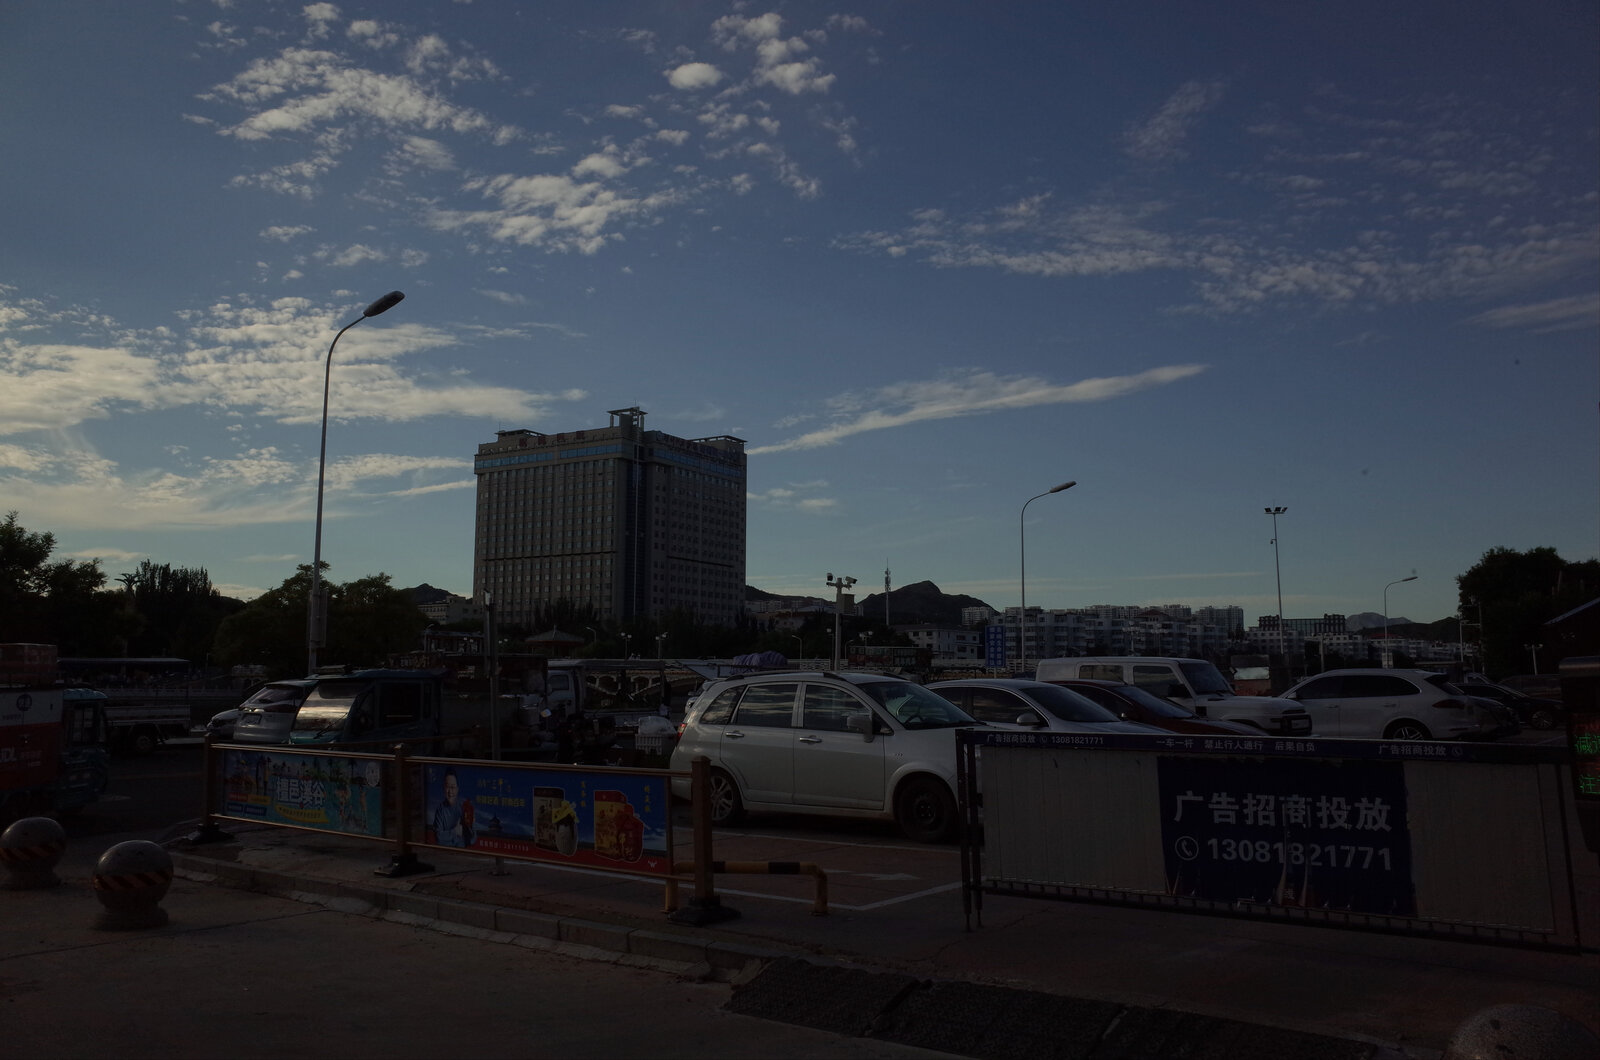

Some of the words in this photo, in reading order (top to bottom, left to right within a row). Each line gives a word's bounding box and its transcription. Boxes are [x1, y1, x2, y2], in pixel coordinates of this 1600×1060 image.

[986, 733, 1036, 744] 广告招商投放
[1051, 735, 1104, 745] 13081821771
[1156, 738, 1194, 749] 一车一杆
[1204, 739, 1264, 752] 禁止行人通行
[1274, 741, 1316, 753] 后果自负
[1378, 743, 1447, 757] 广告招商投放
[1173, 790, 1393, 832] 广告招商投放
[1207, 838, 1392, 872] 13081821771
